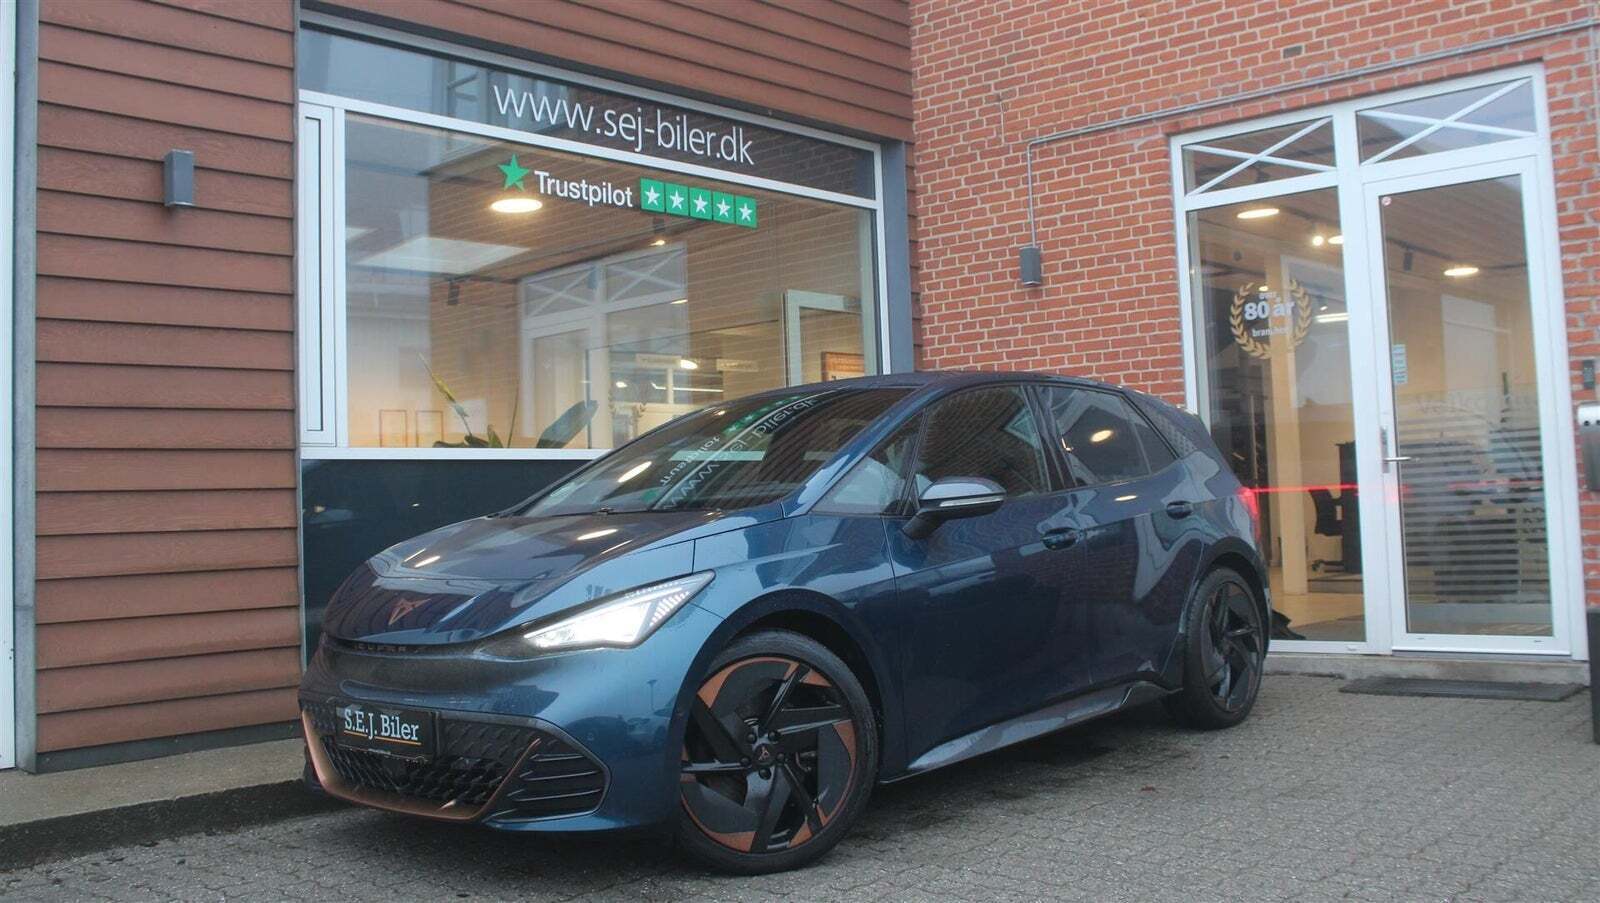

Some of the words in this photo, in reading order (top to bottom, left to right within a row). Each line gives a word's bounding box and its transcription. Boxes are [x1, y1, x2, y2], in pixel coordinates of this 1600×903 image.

[493, 84, 755, 165] www.sej-biler.dk
[534, 170, 633, 207] Trustpilot
[1244, 301, 1270, 320] 80
[344, 708, 378, 740] S.E.J.
[380, 714, 420, 741] Biler
